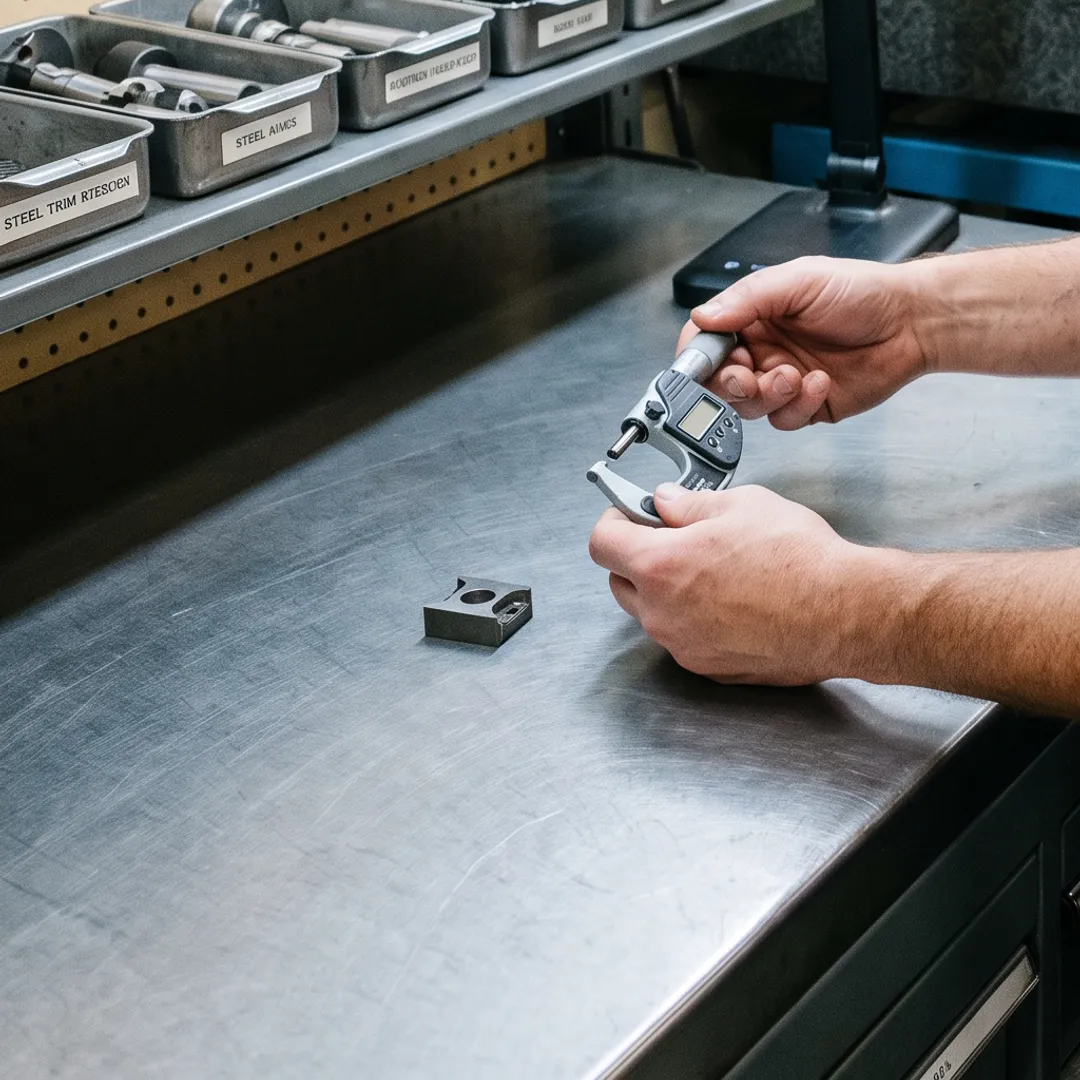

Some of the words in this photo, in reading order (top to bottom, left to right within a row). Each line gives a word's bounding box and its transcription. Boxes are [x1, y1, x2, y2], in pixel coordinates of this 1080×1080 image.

[236, 129, 266, 148] STEEL
[4, 207, 44, 230] STEEL
[46, 195, 77, 214] TRIM
